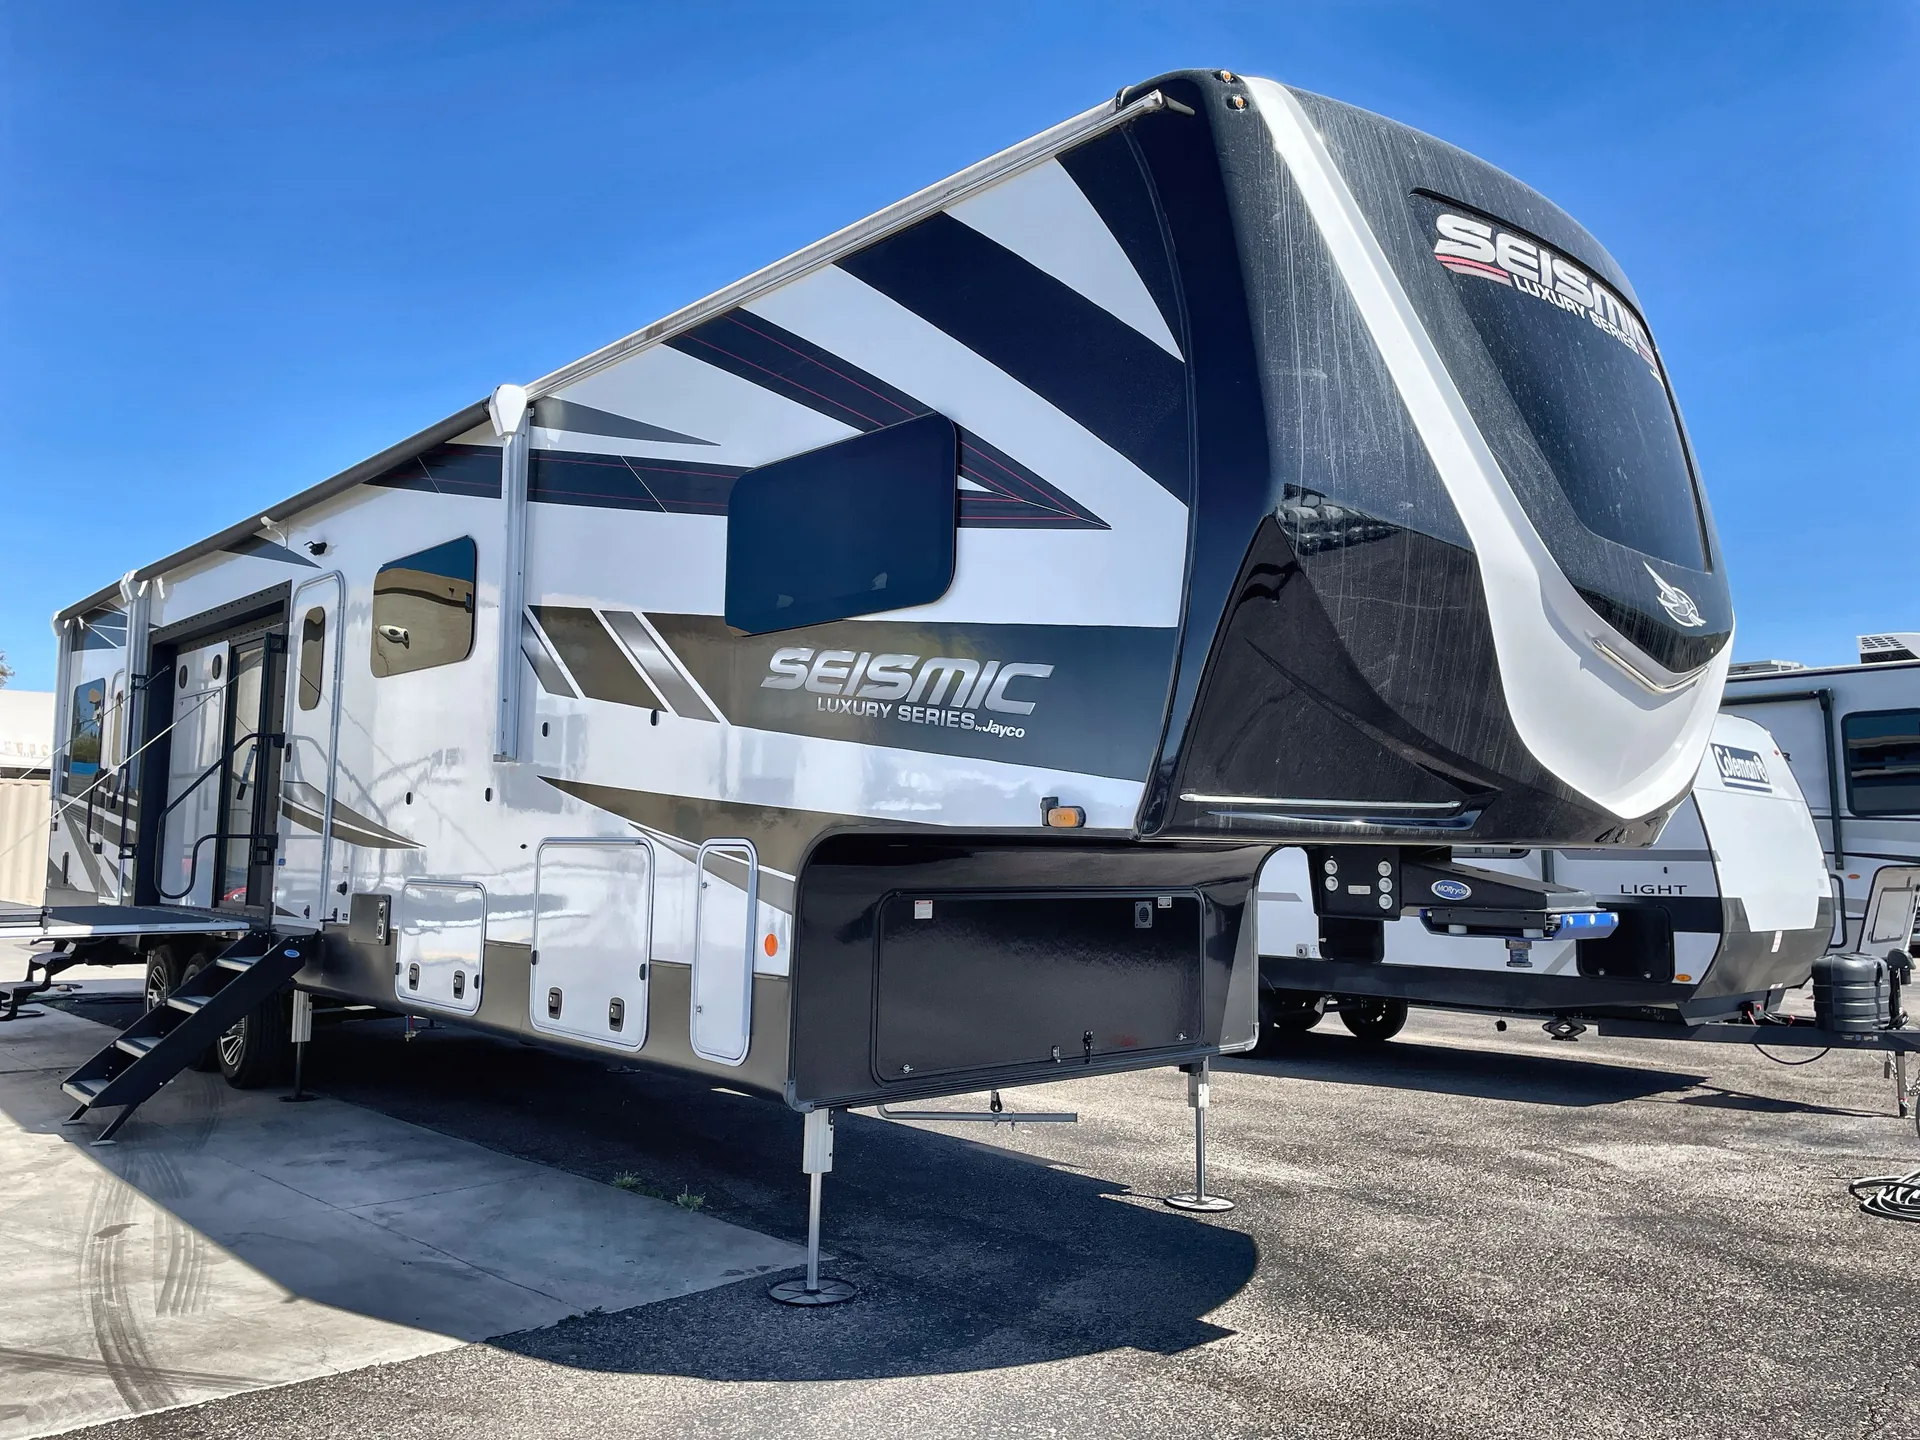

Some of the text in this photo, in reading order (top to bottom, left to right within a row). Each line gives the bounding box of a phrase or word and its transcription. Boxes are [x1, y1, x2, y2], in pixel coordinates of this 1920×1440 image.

[1512, 275, 1639, 354] LUXURY SERIES
[760, 646, 1056, 716] SEISMIC
[816, 697, 893, 719] LUXURY
[897, 704, 976, 730] SERIES
[982, 719, 1026, 738] Jayco
[1713, 745, 1761, 781] Coleman
[1620, 884, 1688, 895] LIGHT
